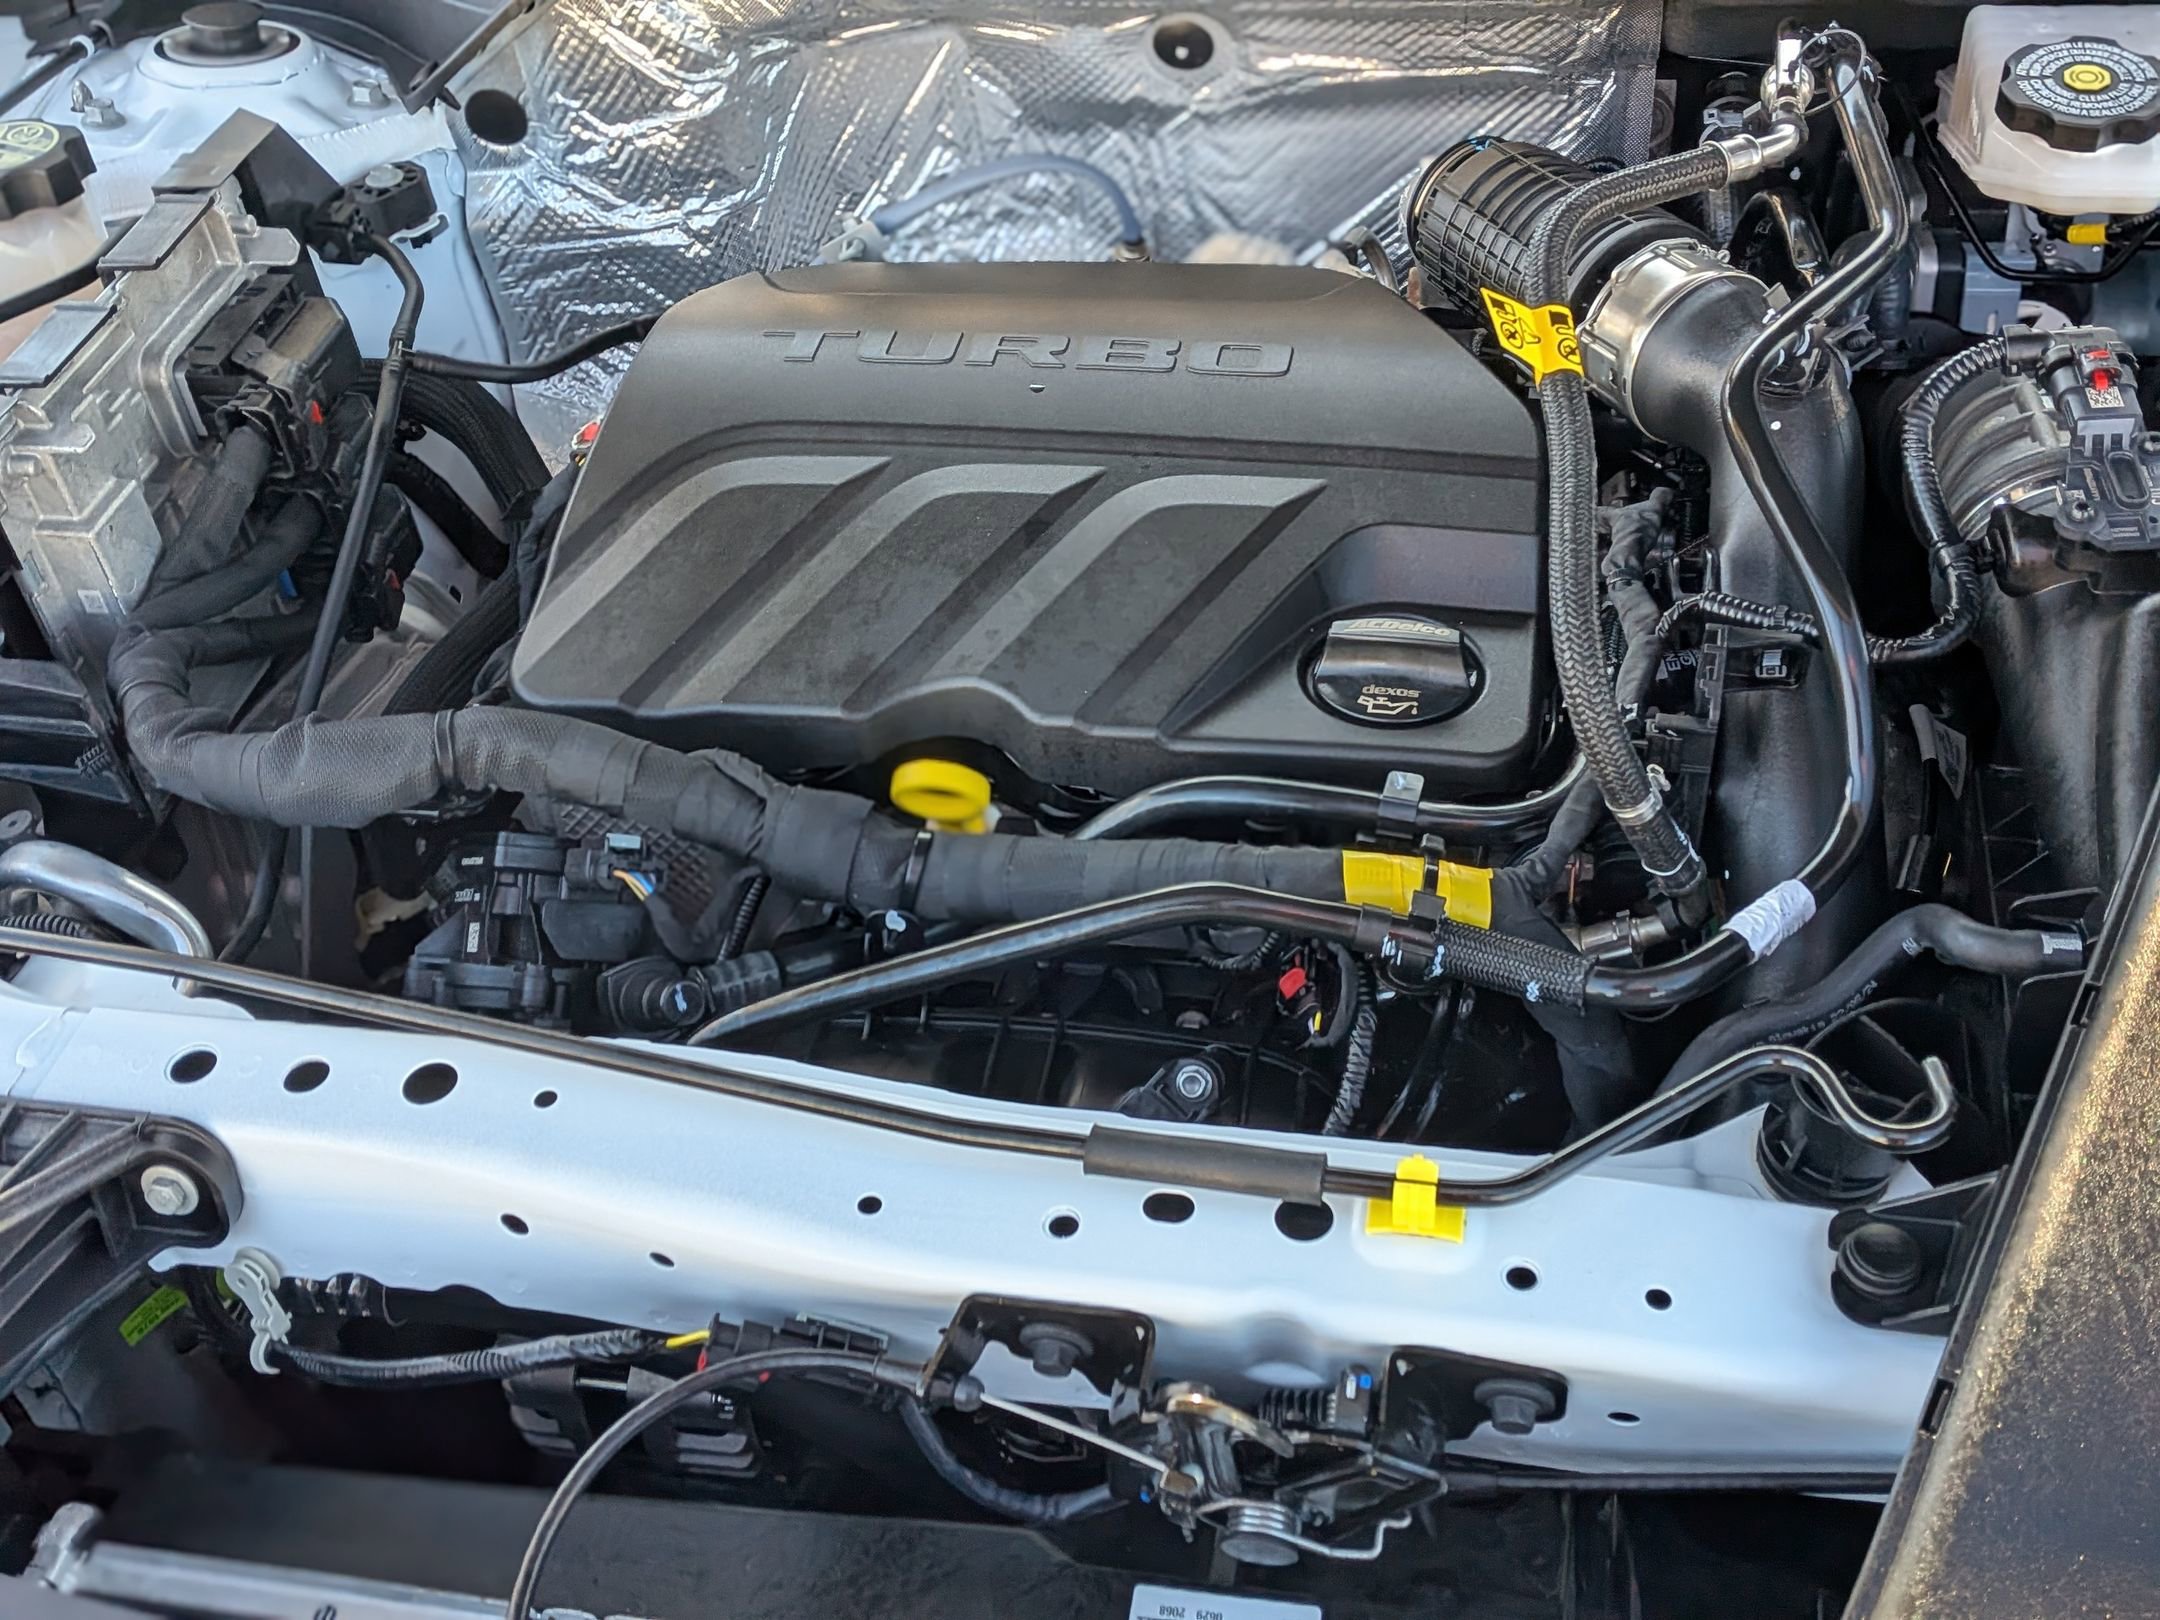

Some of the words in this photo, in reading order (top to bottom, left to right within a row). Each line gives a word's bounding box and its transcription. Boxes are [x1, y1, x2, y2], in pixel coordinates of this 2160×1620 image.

[2050, 102, 2081, 116] FROM
[763, 330, 1294, 376] TURBO
[1344, 620, 1451, 636] ACDelco
[1362, 684, 1421, 698] dexos
